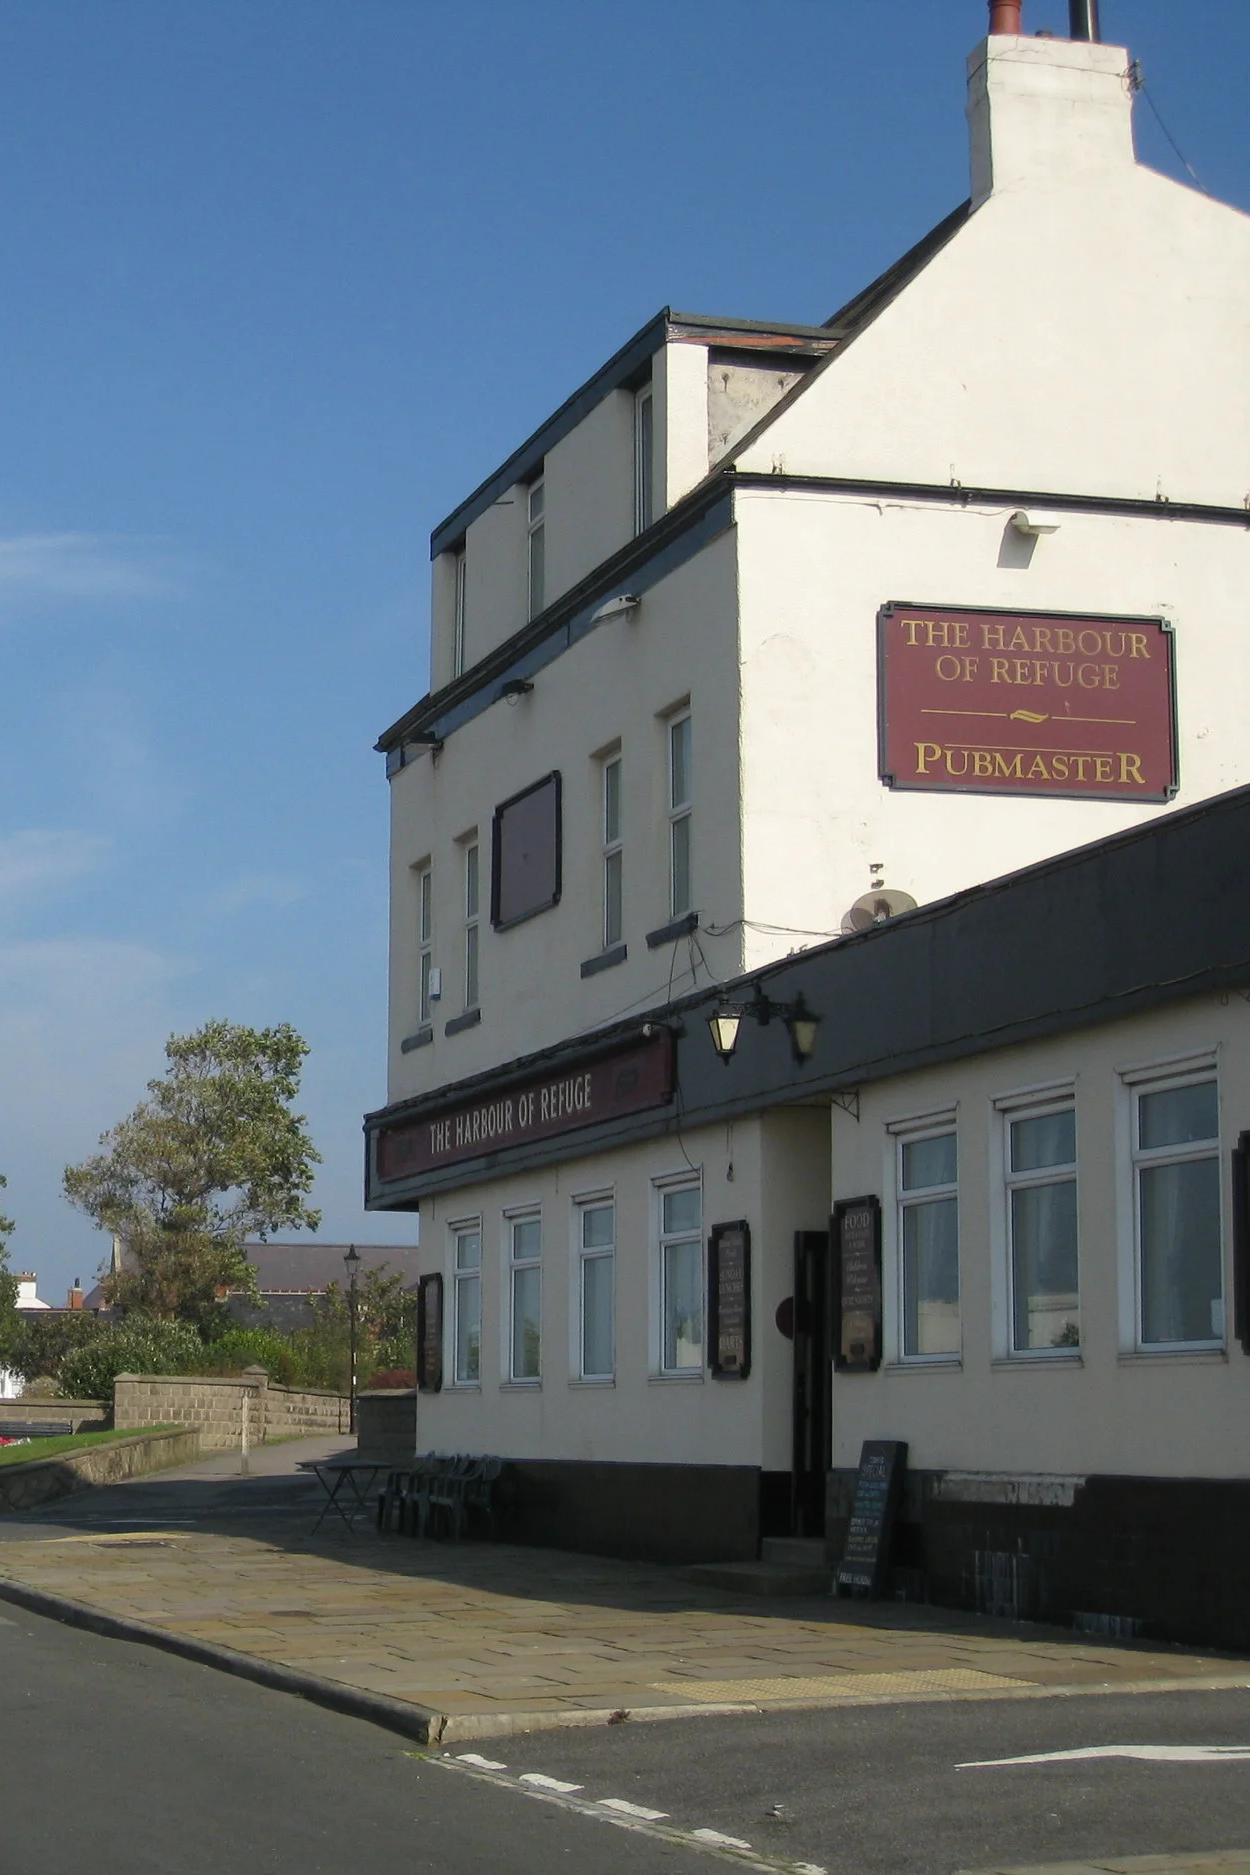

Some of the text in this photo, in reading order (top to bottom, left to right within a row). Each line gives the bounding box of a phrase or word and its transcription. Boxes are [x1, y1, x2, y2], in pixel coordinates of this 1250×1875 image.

[901, 620, 1150, 658] THE HARBOUR
[936, 655, 1120, 690] OF REFUGE
[914, 742, 1146, 784] PUBMASTER
[430, 1074, 592, 1154] THE HARBOUR OF REFUGE
